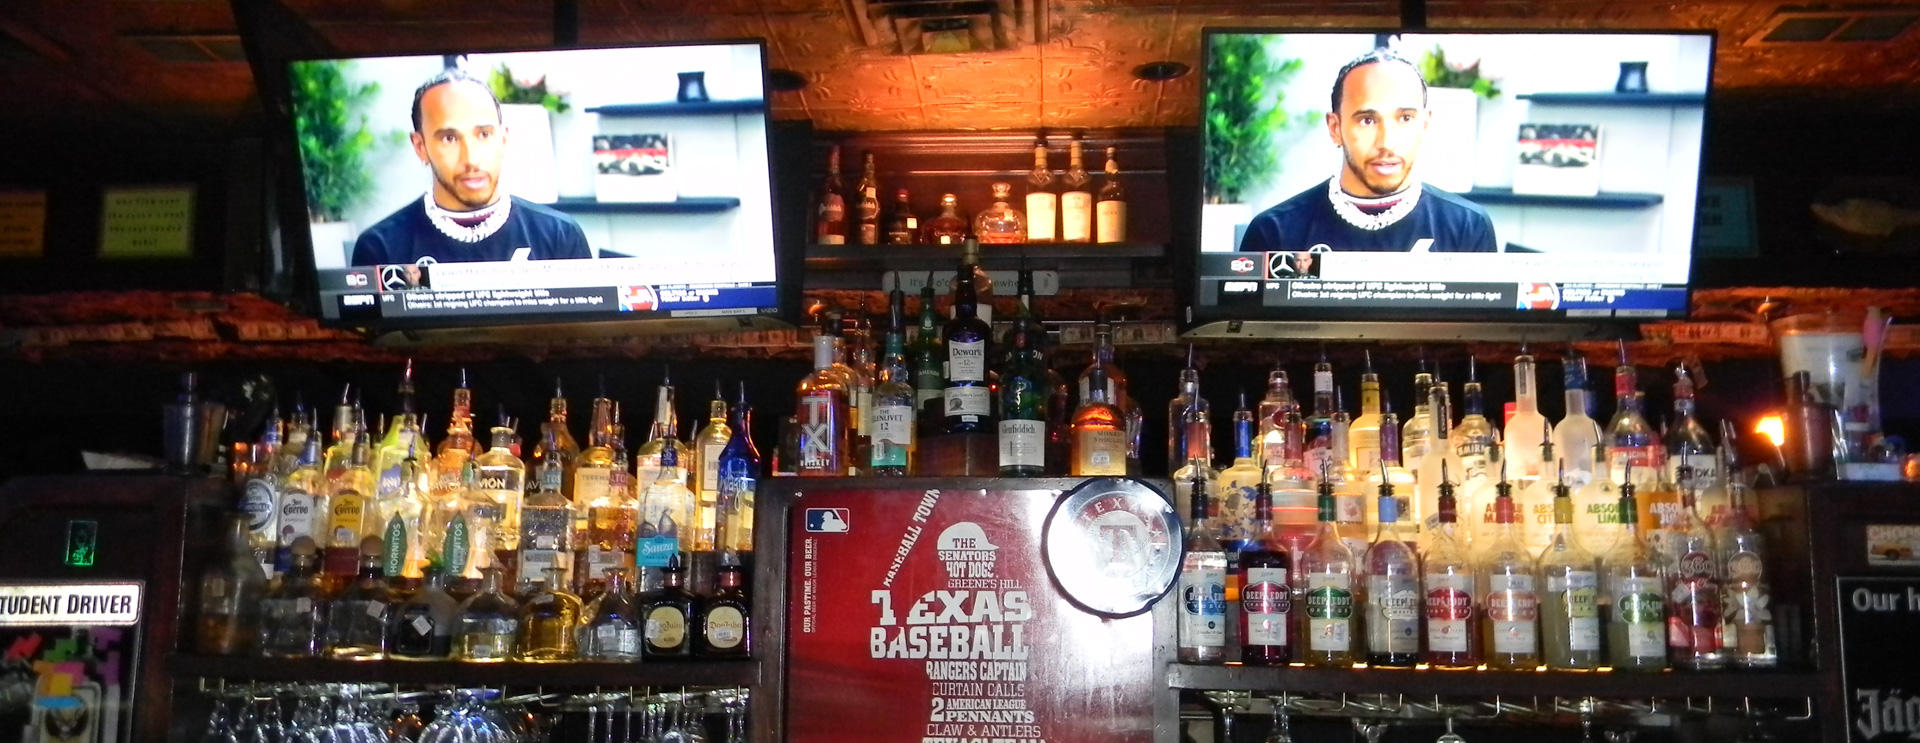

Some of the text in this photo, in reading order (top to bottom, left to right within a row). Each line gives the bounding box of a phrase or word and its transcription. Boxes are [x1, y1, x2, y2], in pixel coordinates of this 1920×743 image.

[1224, 282, 1258, 292] ESPN
[344, 294, 375, 306] ESPN
[880, 422, 889, 430] 12
[1457, 442, 1486, 456] SMIRN
[912, 488, 942, 524] TOWN
[390, 523, 400, 573] HORNITOS
[642, 542, 674, 555] Sauza
[952, 538, 976, 548] THE
[938, 550, 996, 562] SENATORS
[946, 562, 995, 578] HOT DOGS
[948, 579, 1022, 588] GREENE'S HILL
[67, 594, 132, 614] DRIVER
[804, 578, 812, 616] PASTIME.
[1852, 586, 1920, 612] Our h
[871, 590, 1033, 626] TEXAS
[870, 624, 1030, 660] BASEBALL
[926, 661, 1027, 680] RANGERS CAPTAIN
[932, 682, 1025, 697] CURTAIN CALLS
[930, 697, 944, 722] 2
[946, 698, 1027, 710] AMERICAN LEAGUE
[946, 710, 1034, 724] PENNANTS
[1857, 688, 1920, 740] Jäg
[926, 724, 1041, 738] CLAW & ANTLERS
